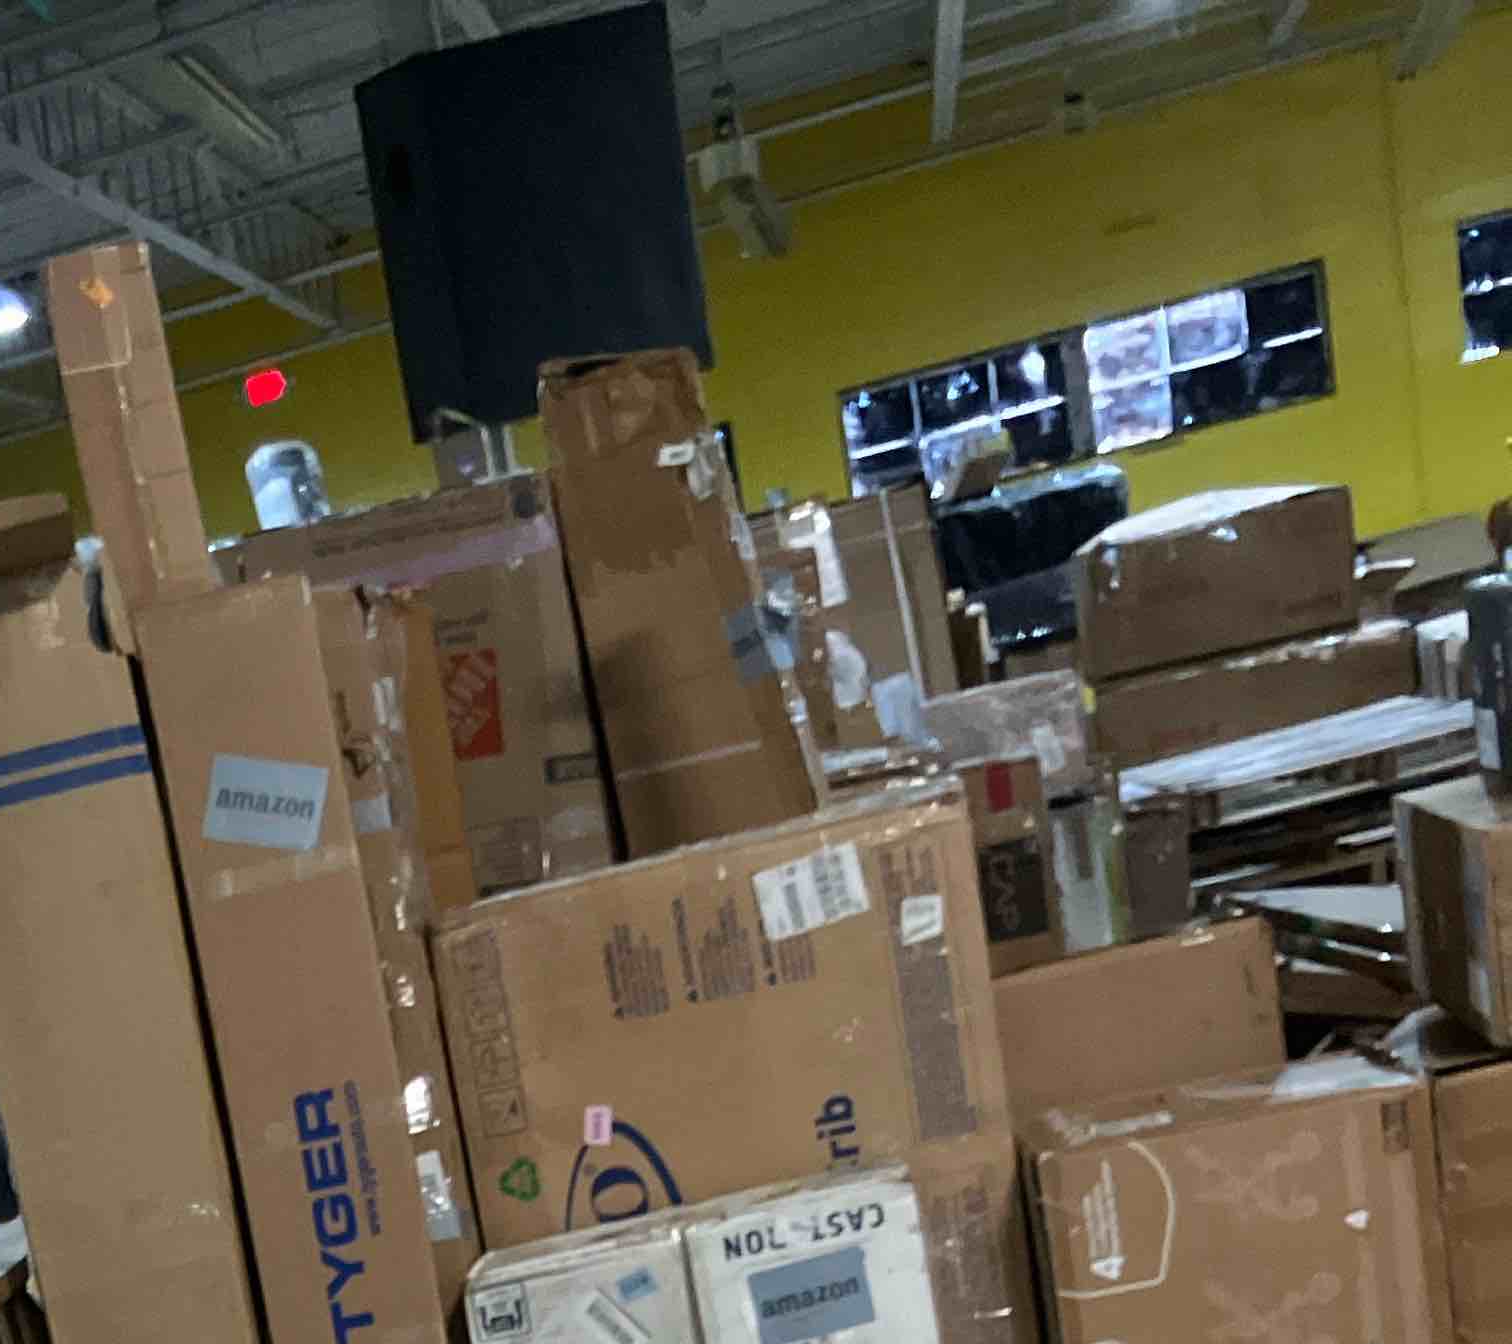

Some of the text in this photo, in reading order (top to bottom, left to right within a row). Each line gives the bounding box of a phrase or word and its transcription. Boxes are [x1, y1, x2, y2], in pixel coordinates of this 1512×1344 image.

[214, 787, 315, 822] amazon
[814, 1095, 860, 1168] rib
[760, 1276, 860, 1319] amazon
